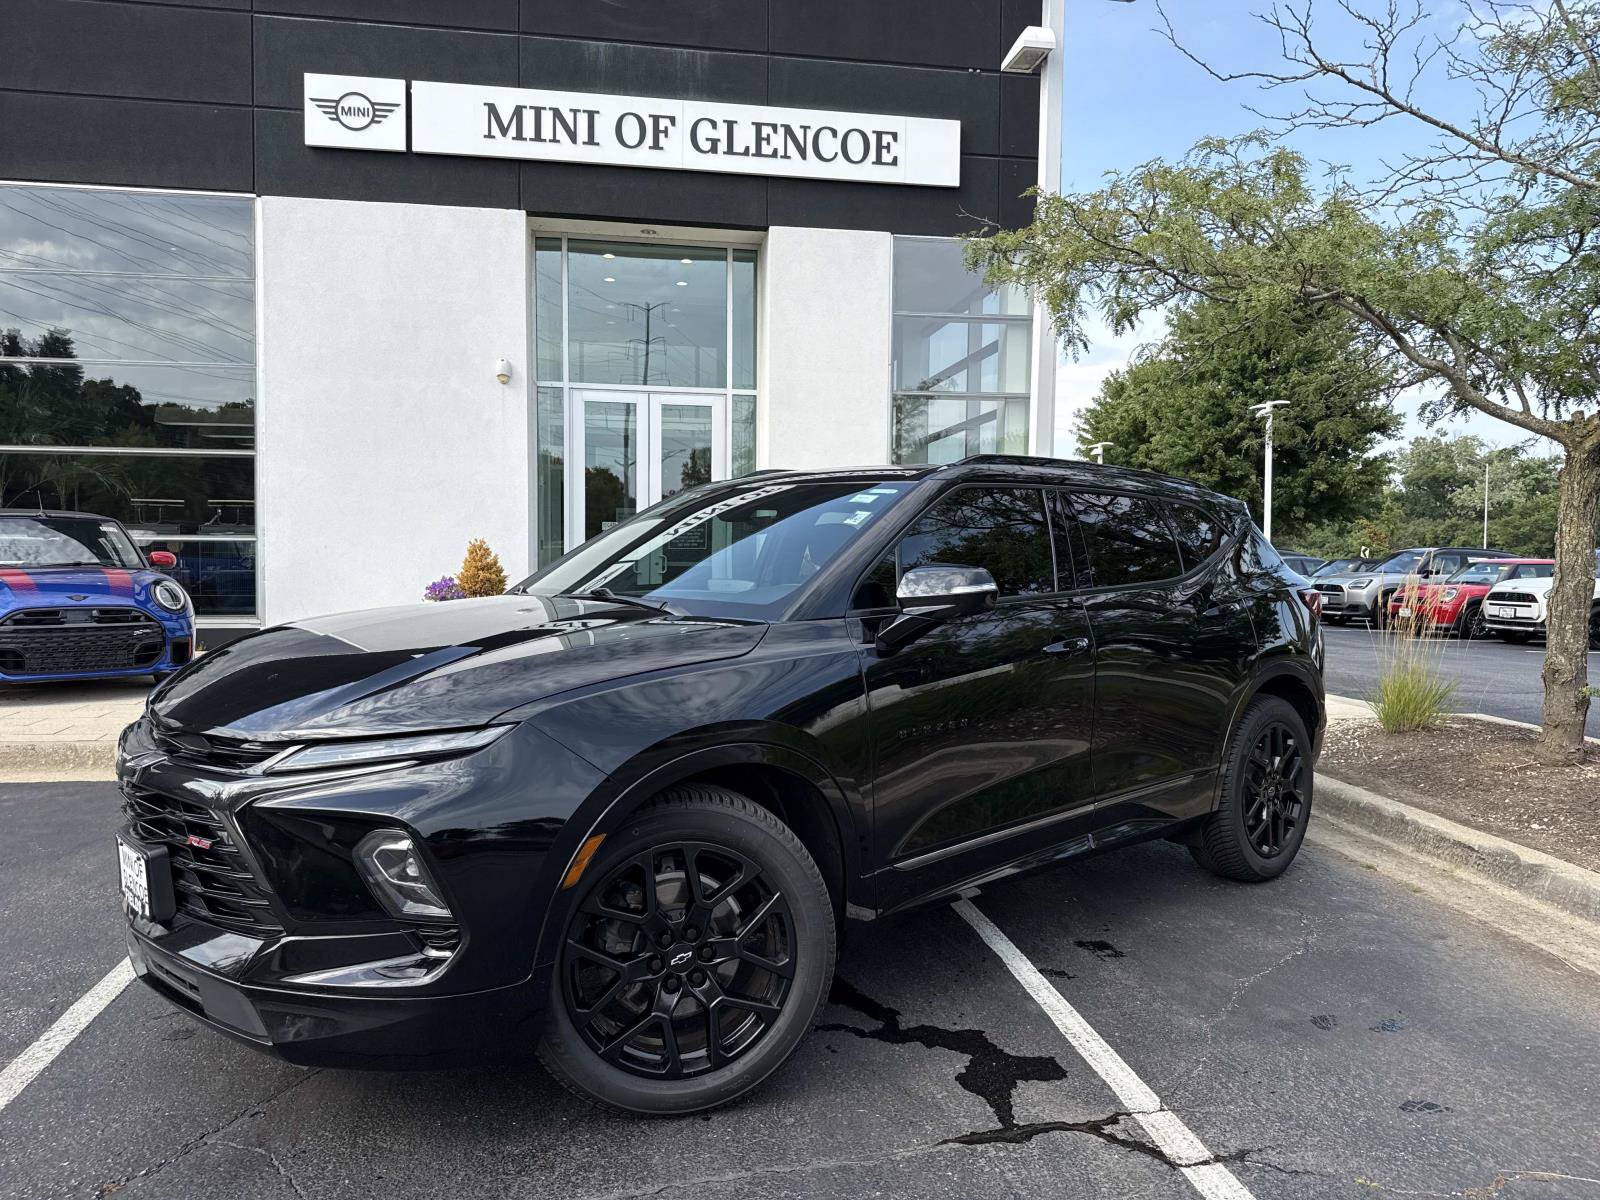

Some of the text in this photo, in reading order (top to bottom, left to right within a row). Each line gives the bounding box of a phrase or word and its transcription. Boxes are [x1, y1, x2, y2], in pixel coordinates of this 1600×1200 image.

[341, 105, 370, 118] MINI
[483, 102, 898, 167] MINI OF GLENCOE
